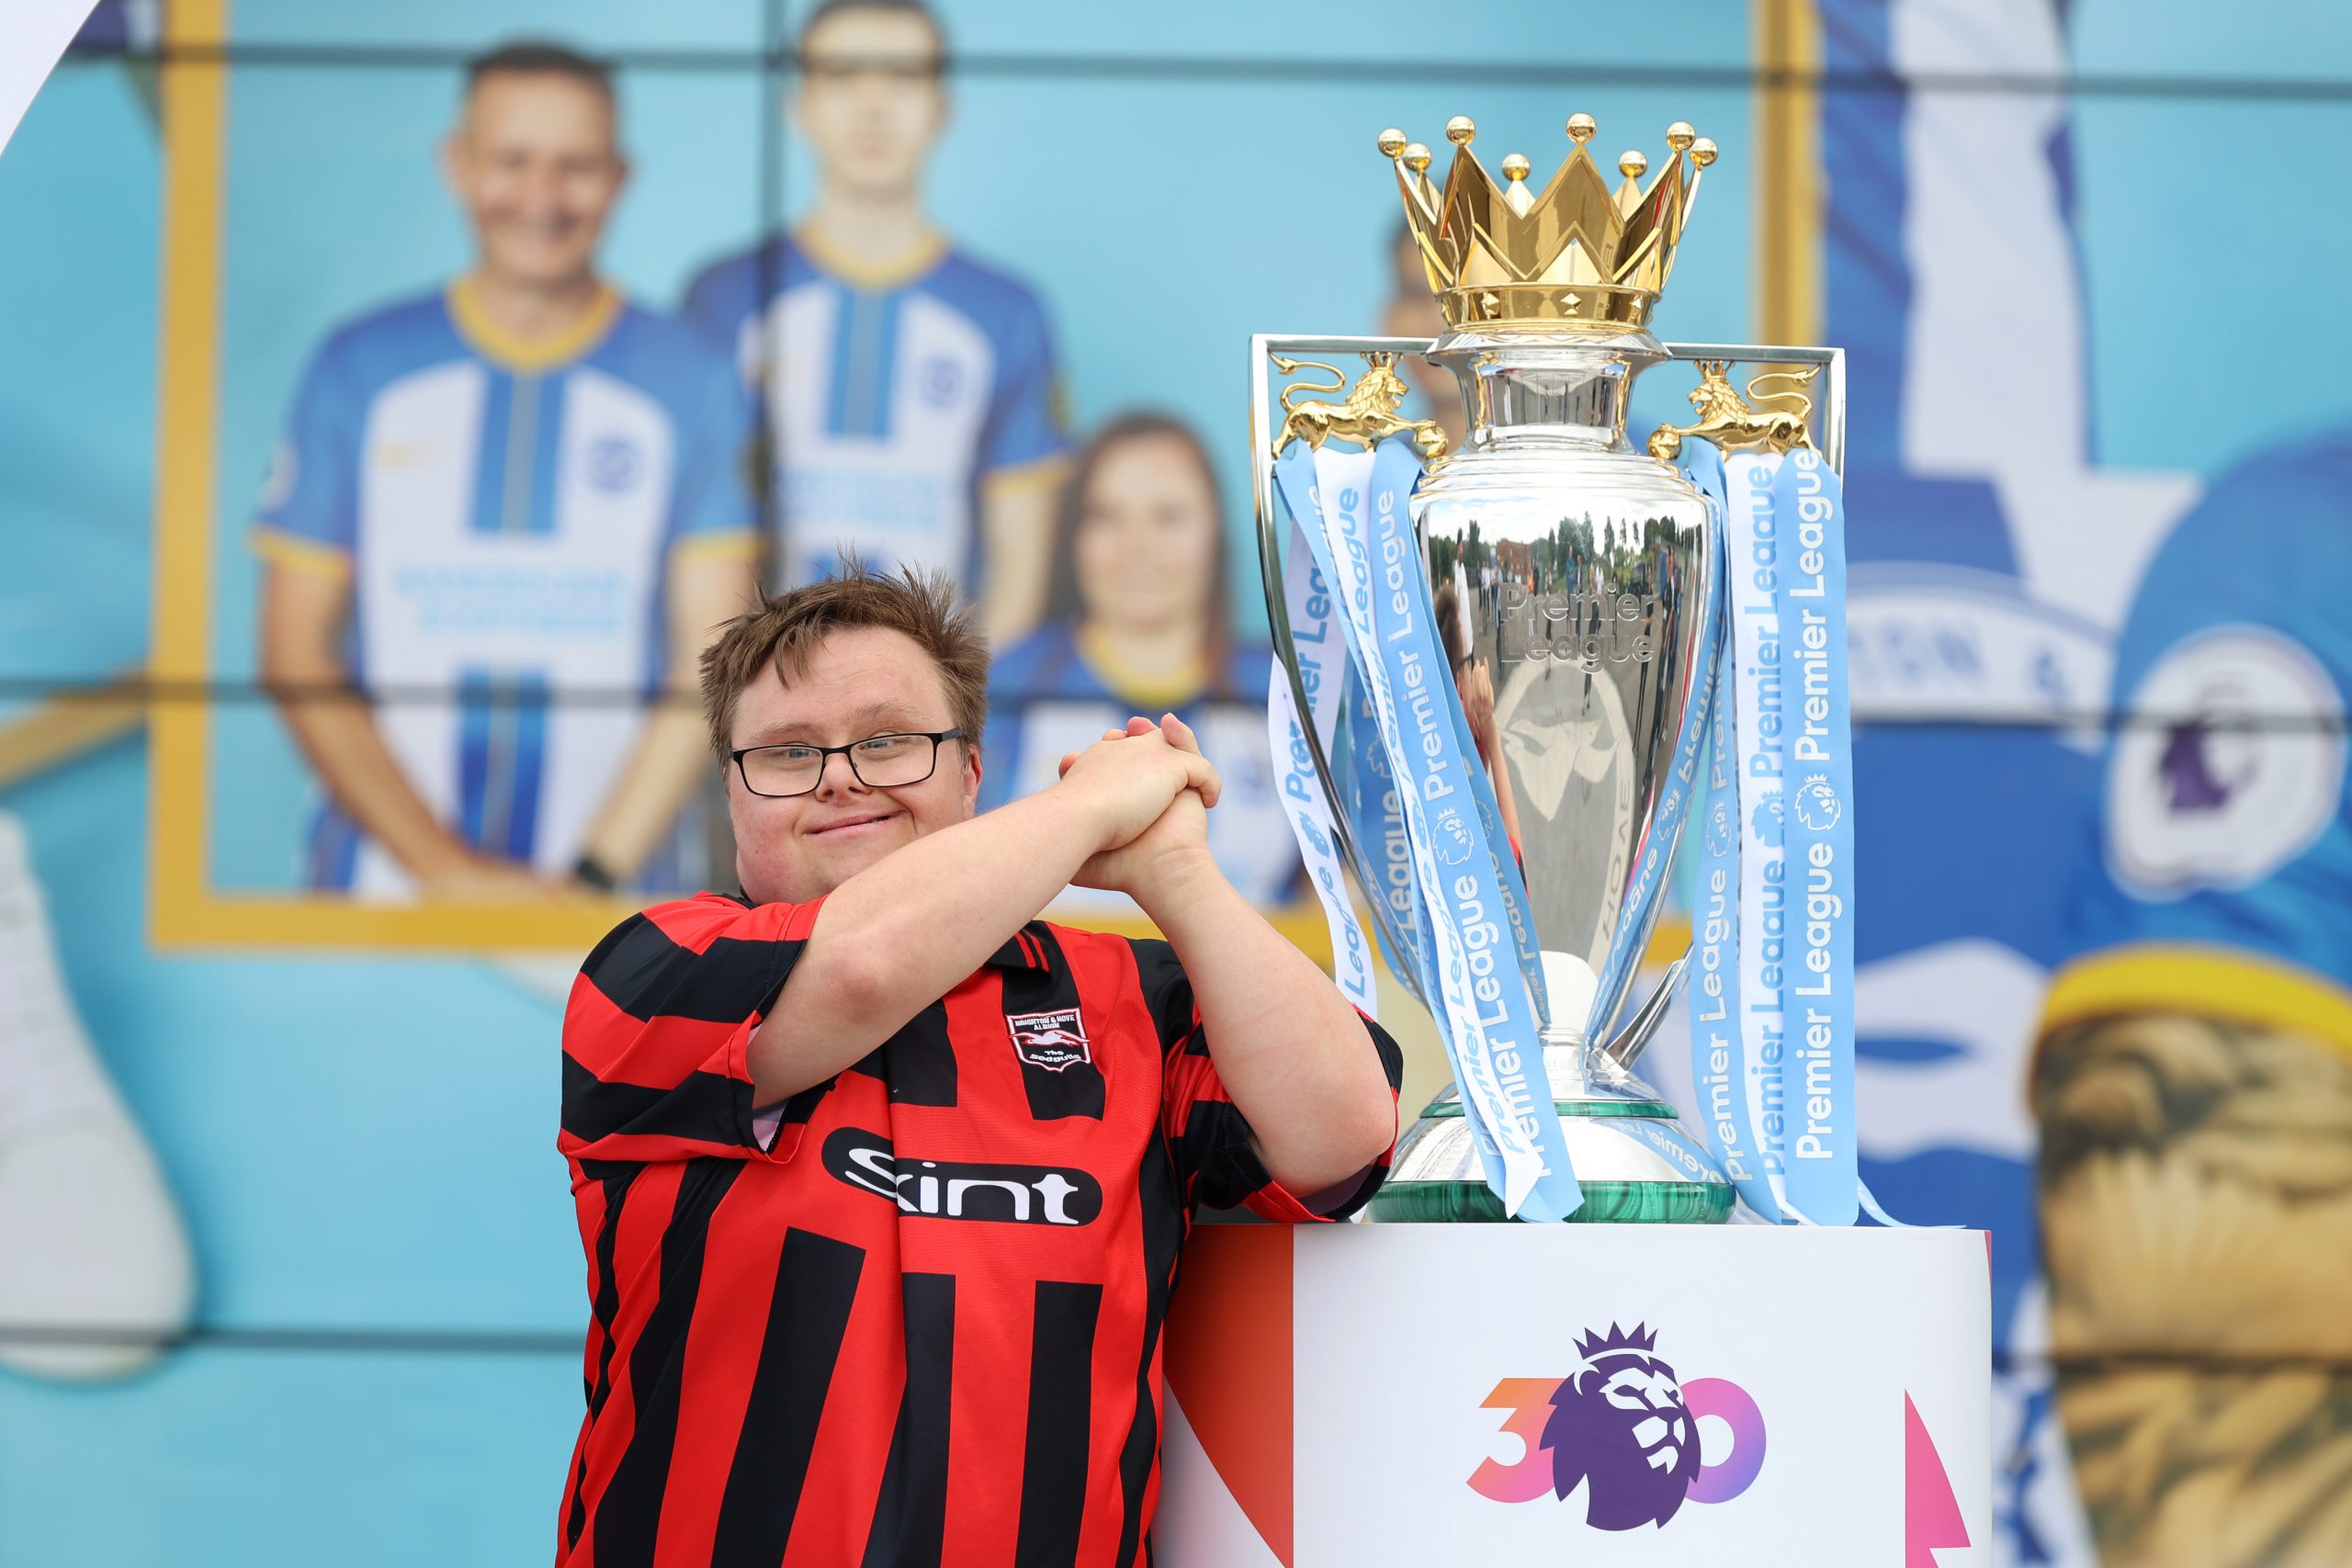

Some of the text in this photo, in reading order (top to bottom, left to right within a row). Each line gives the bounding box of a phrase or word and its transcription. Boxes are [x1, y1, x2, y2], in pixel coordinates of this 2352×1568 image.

[1338, 487, 1372, 636] League
[1498, 581, 1656, 622] Premier
[1745, 465, 1783, 778] Premier League
[1790, 448, 1833, 761] Premier League
[1377, 490, 1455, 802] Premier League
[1498, 633, 1656, 675] League
[1014, 1014, 1076, 1027] BRIGHTON & HOVE
[1034, 1021, 1060, 1031] ALBION
[1453, 874, 1510, 1027] League
[1700, 868, 1754, 1182] Premier League
[1750, 859, 1785, 1176] Premier League
[1794, 841, 1844, 1159] Premier League
[1466, 1377, 1767, 1503] 30
